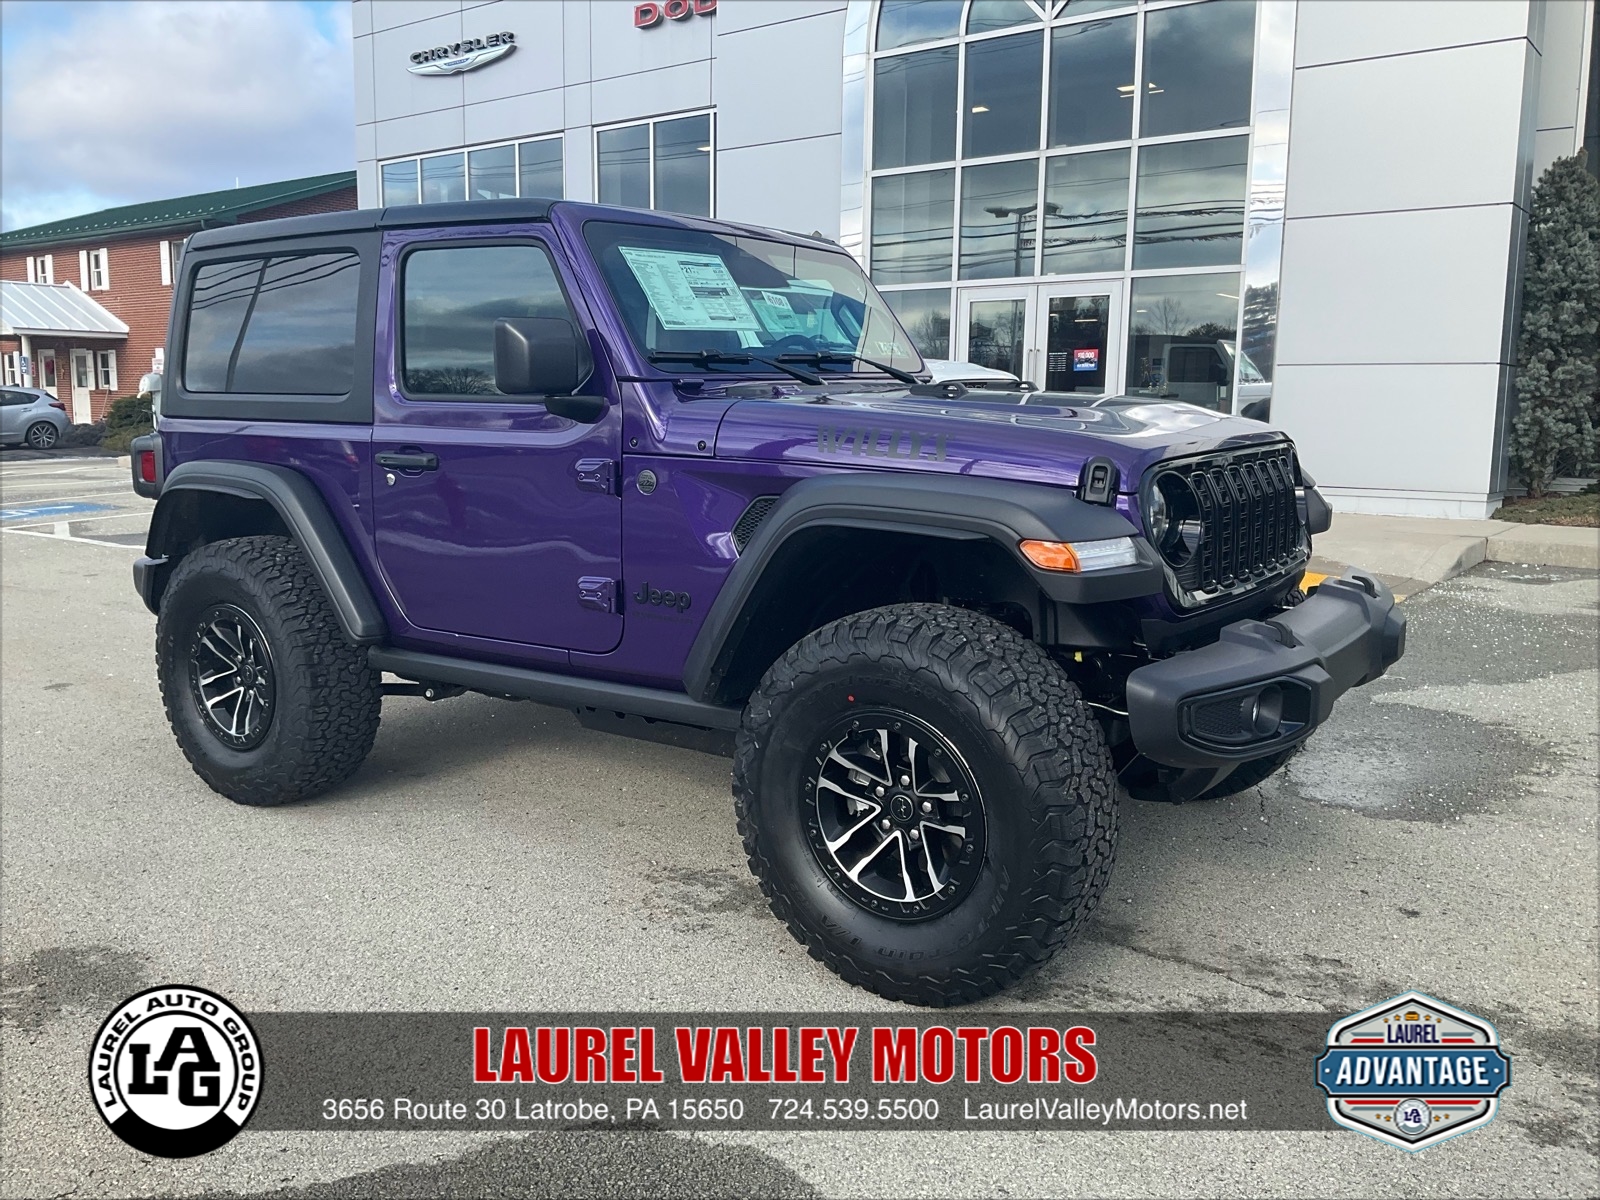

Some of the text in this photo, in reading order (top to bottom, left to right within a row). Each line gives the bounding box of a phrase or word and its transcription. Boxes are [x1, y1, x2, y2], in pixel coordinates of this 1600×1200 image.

[410, 31, 515, 64] CHRYSLER
[816, 424, 948, 462] WILLYS
[633, 581, 692, 614] Jeep
